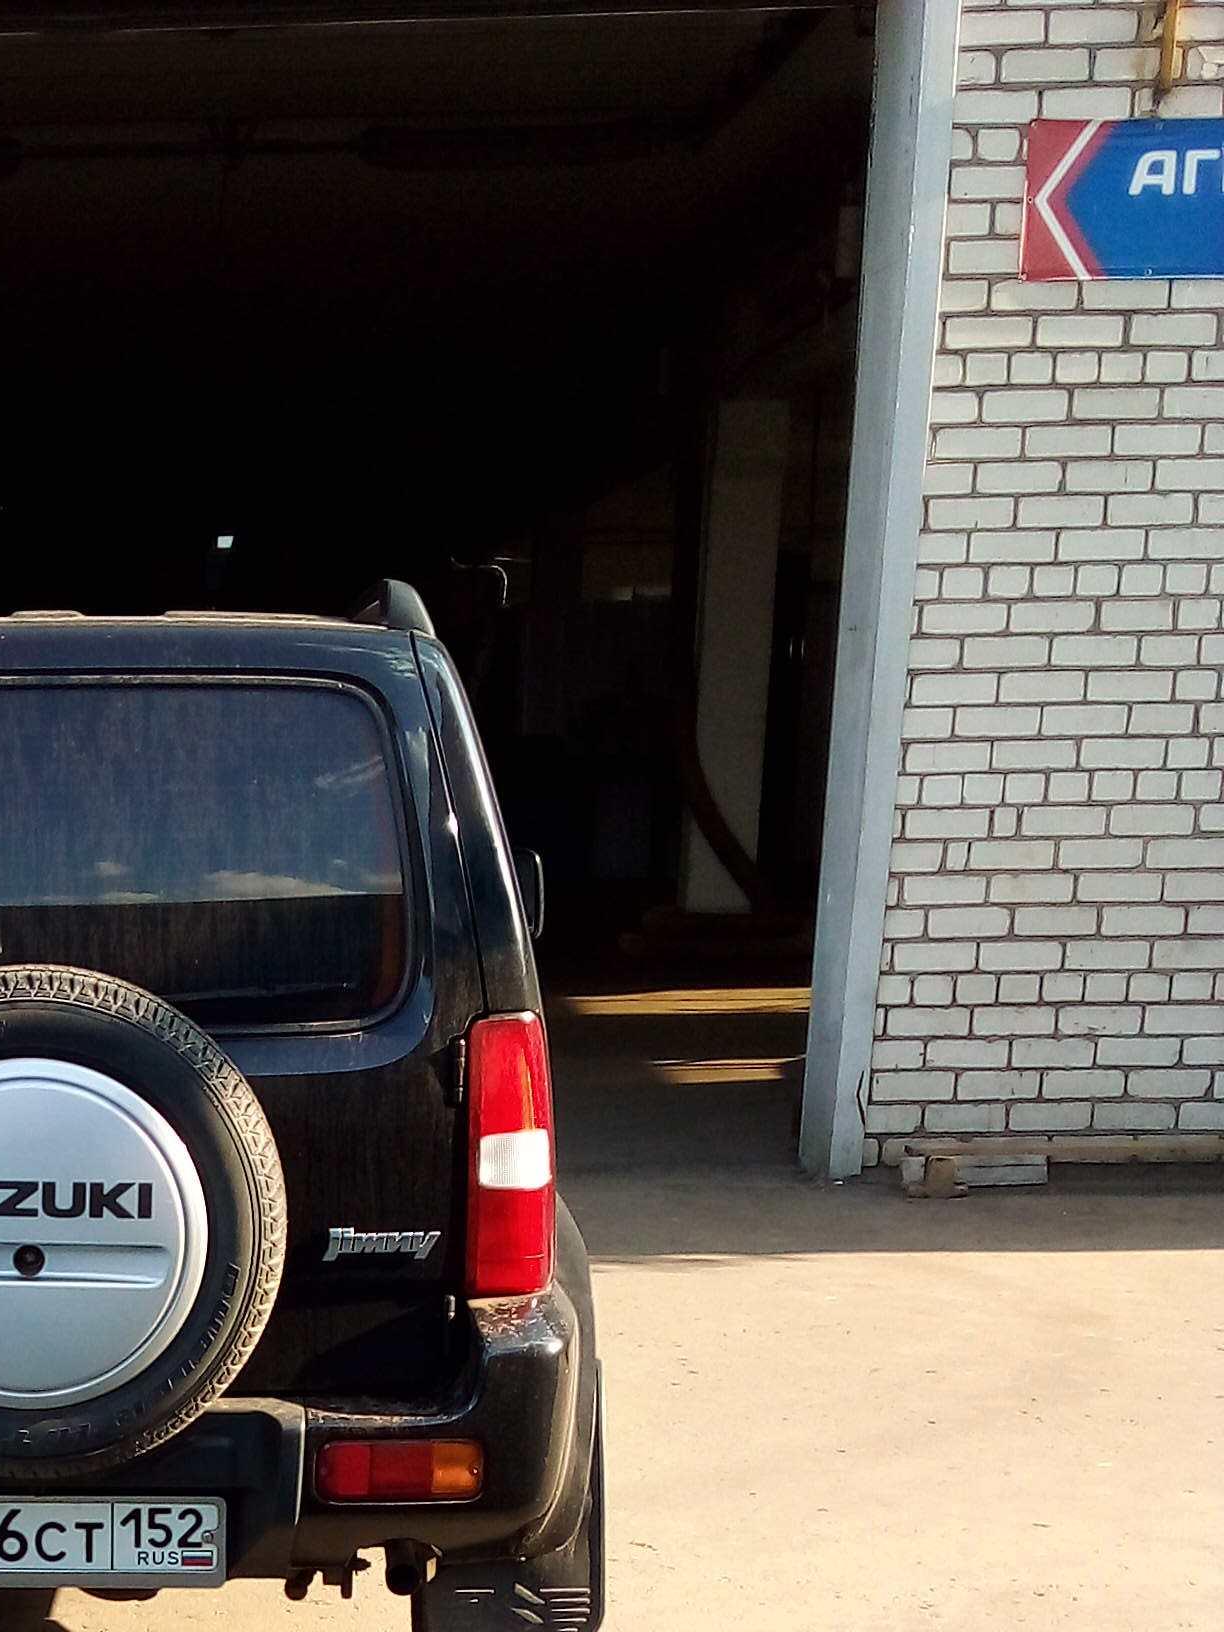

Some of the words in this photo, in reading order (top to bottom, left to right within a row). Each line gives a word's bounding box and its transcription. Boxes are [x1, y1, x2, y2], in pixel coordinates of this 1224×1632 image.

[1128, 146, 1224, 196] АГ
[322, 1226, 442, 1262] Jimny
[119, 1507, 203, 1549] 152
[137, 1550, 180, 1566] RUS
